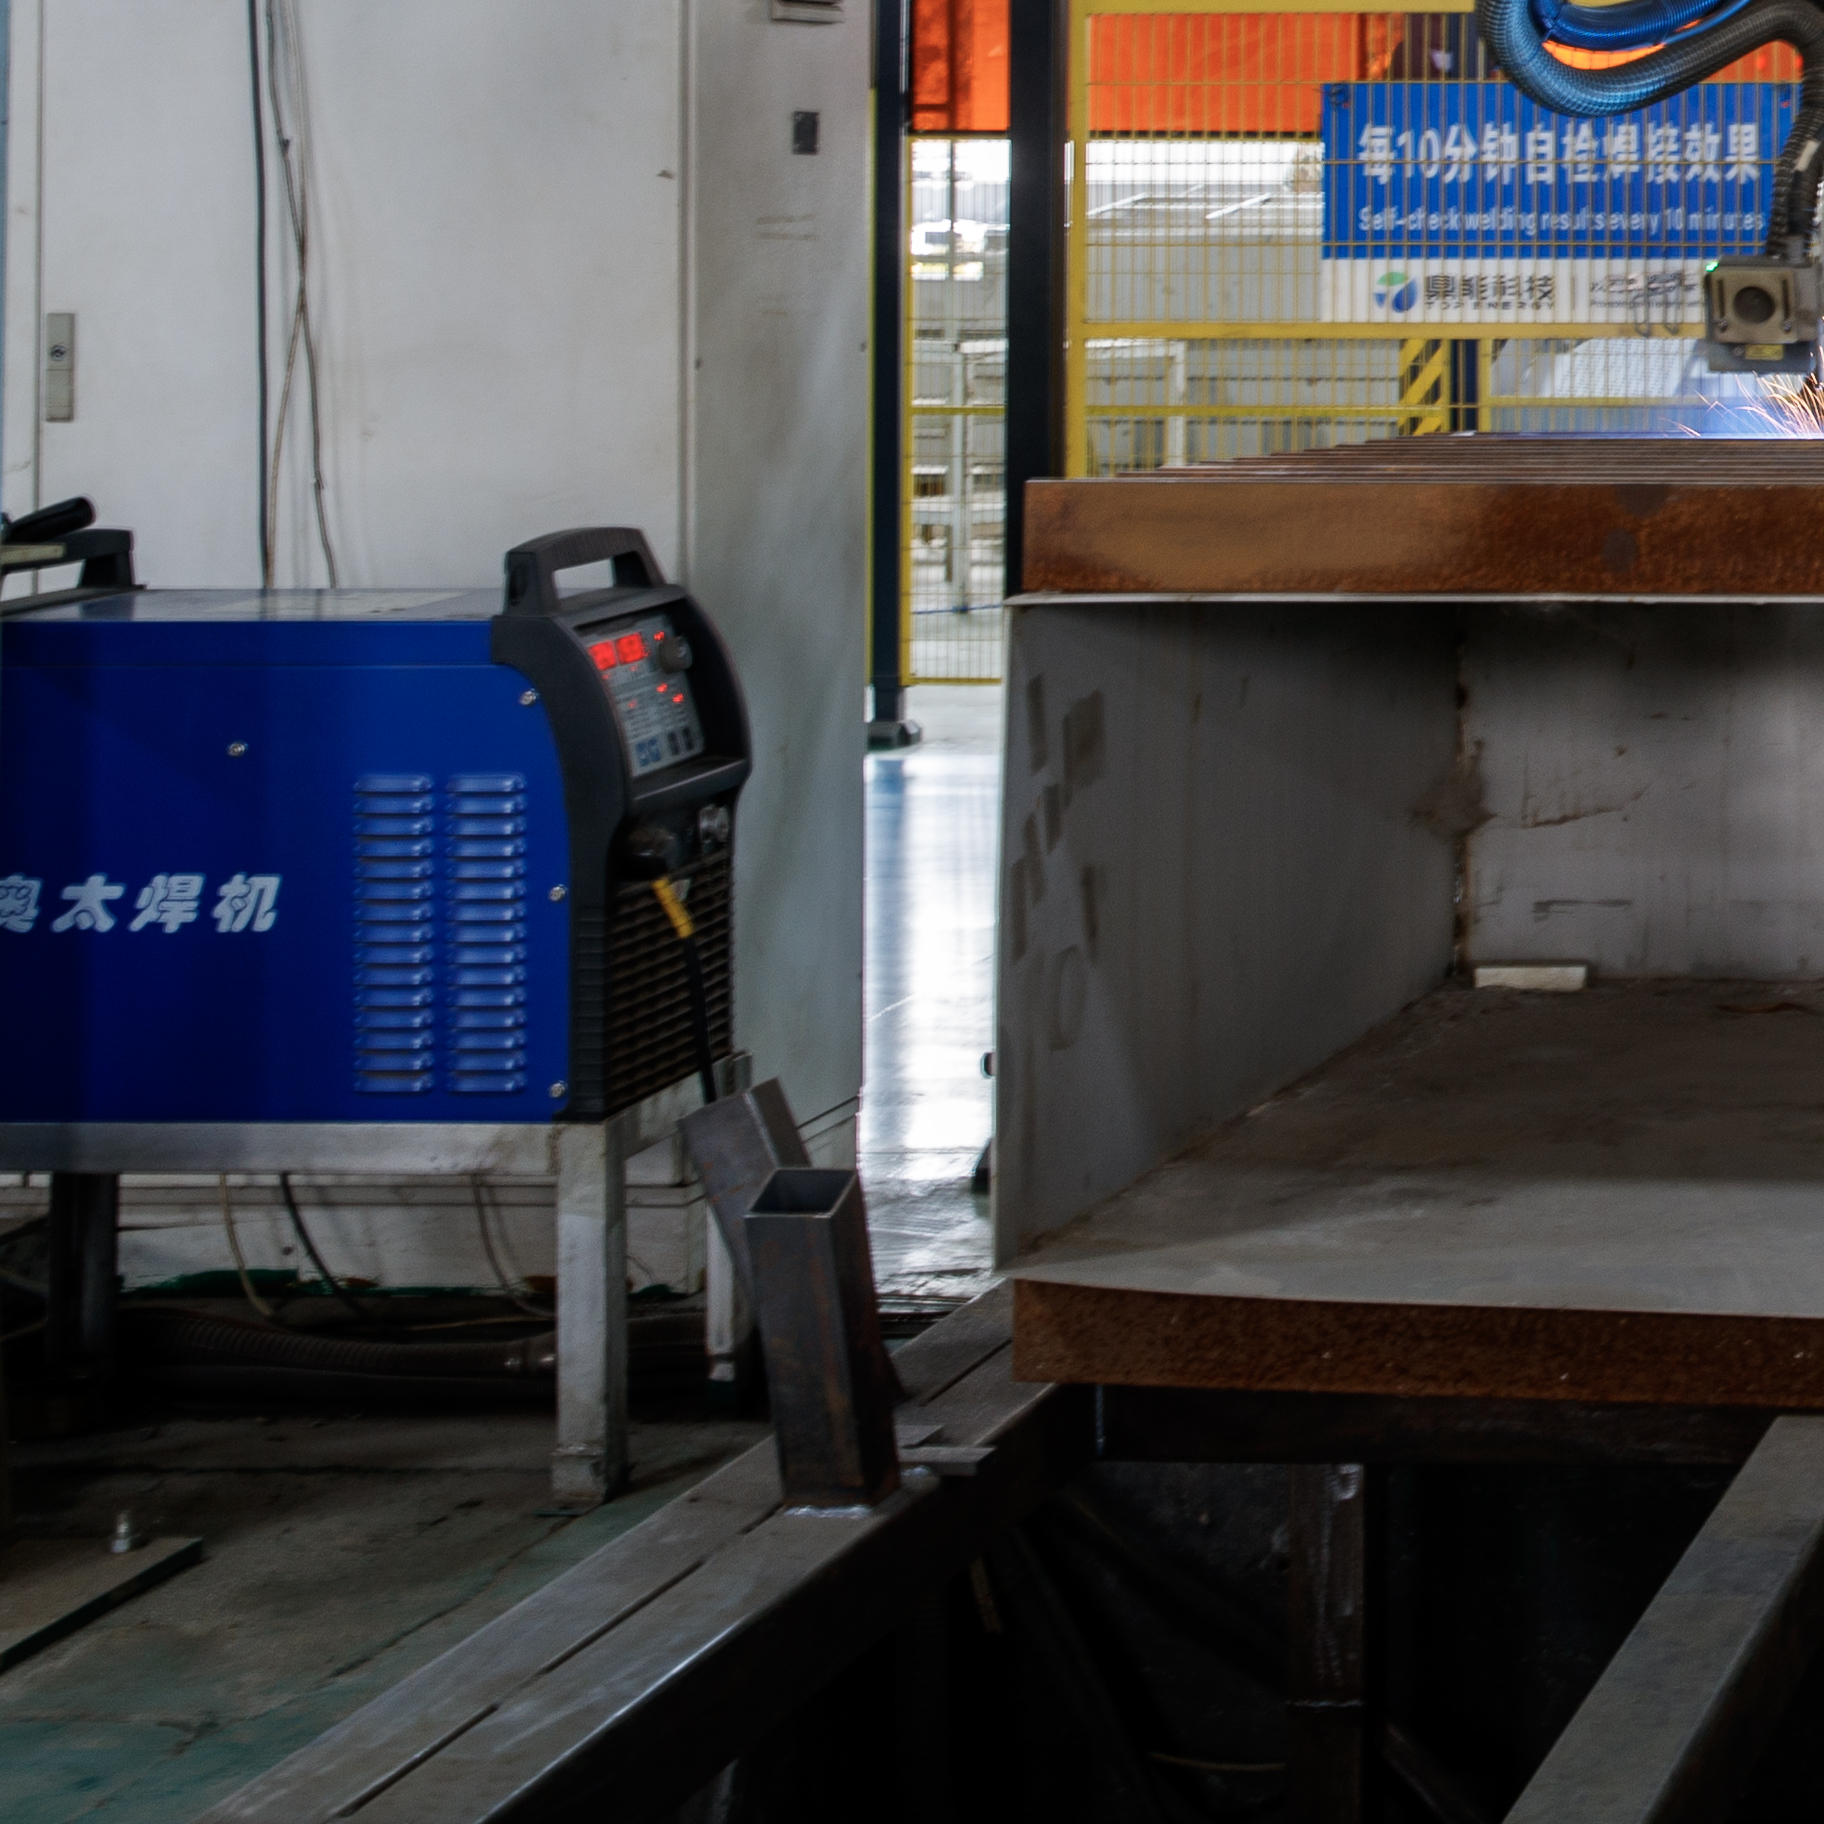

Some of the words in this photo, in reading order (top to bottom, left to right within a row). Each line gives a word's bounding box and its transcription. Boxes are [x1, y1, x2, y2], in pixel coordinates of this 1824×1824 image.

[1358, 123, 1762, 185] 每10分钟自检焊接效果
[1464, 205, 1537, 236] welding
